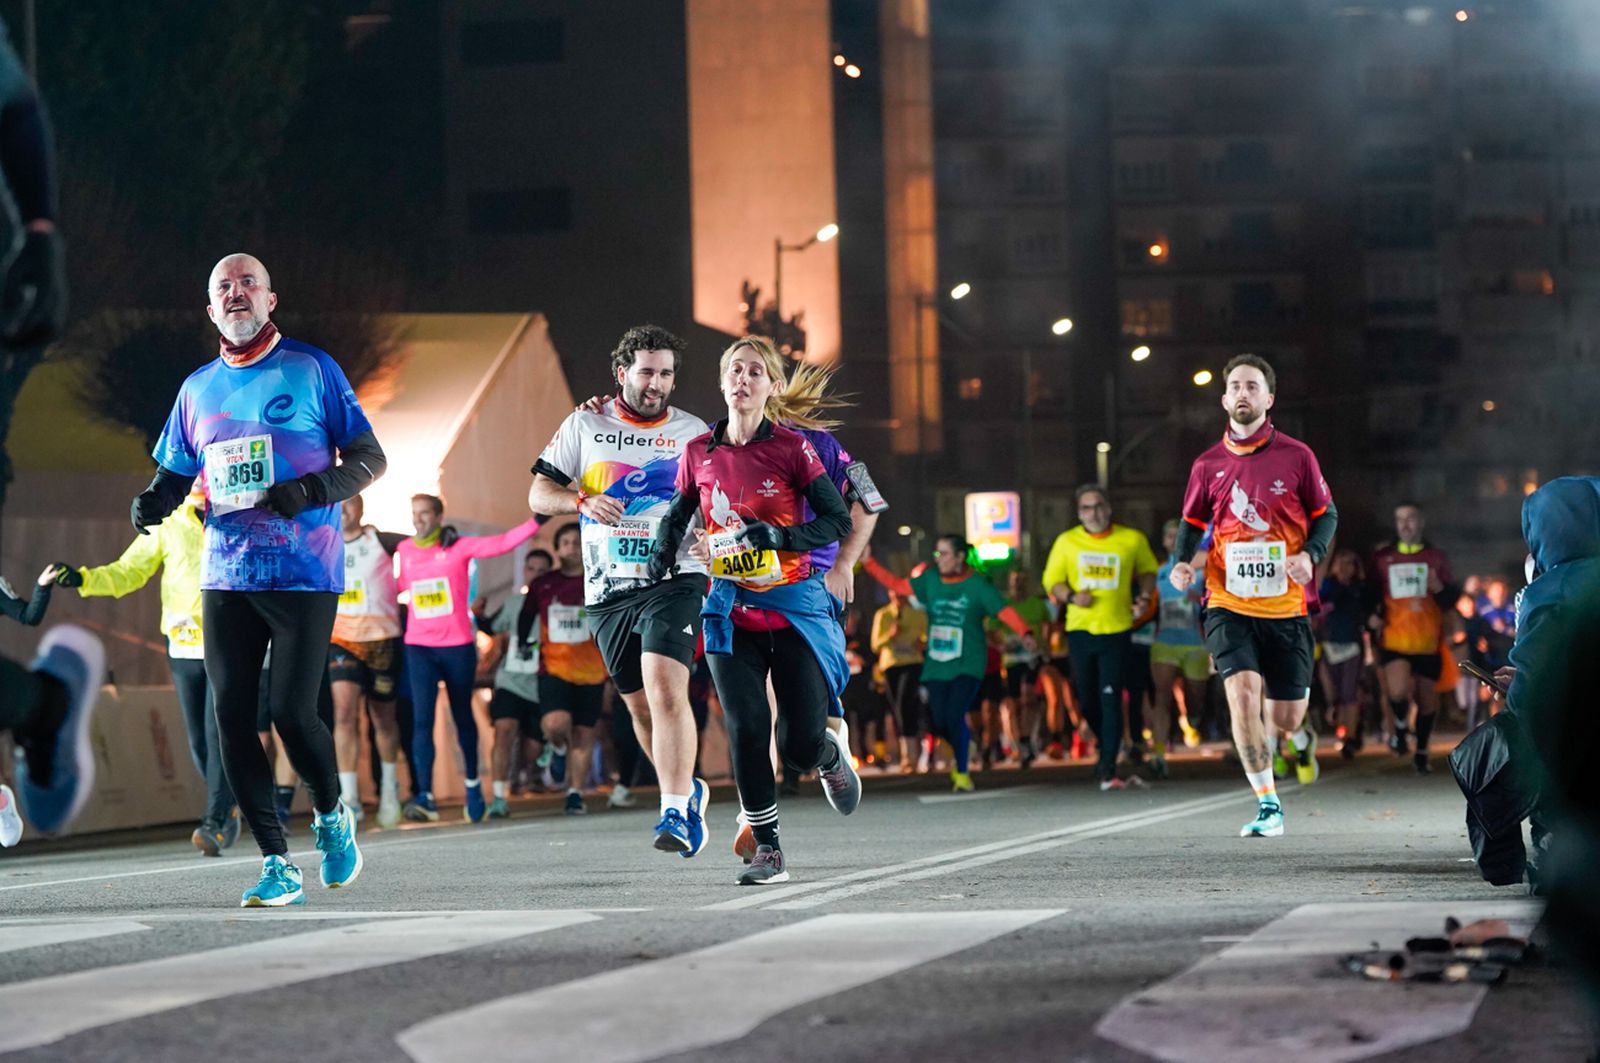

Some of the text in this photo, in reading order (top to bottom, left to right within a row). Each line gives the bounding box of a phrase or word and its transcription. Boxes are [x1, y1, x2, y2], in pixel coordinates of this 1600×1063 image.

[594, 431, 676, 451] calderón
[215, 461, 264, 490] 869
[620, 522, 640, 530] NOCHE
[723, 548, 767, 575] 3402
[1237, 562, 1276, 579] 4493
